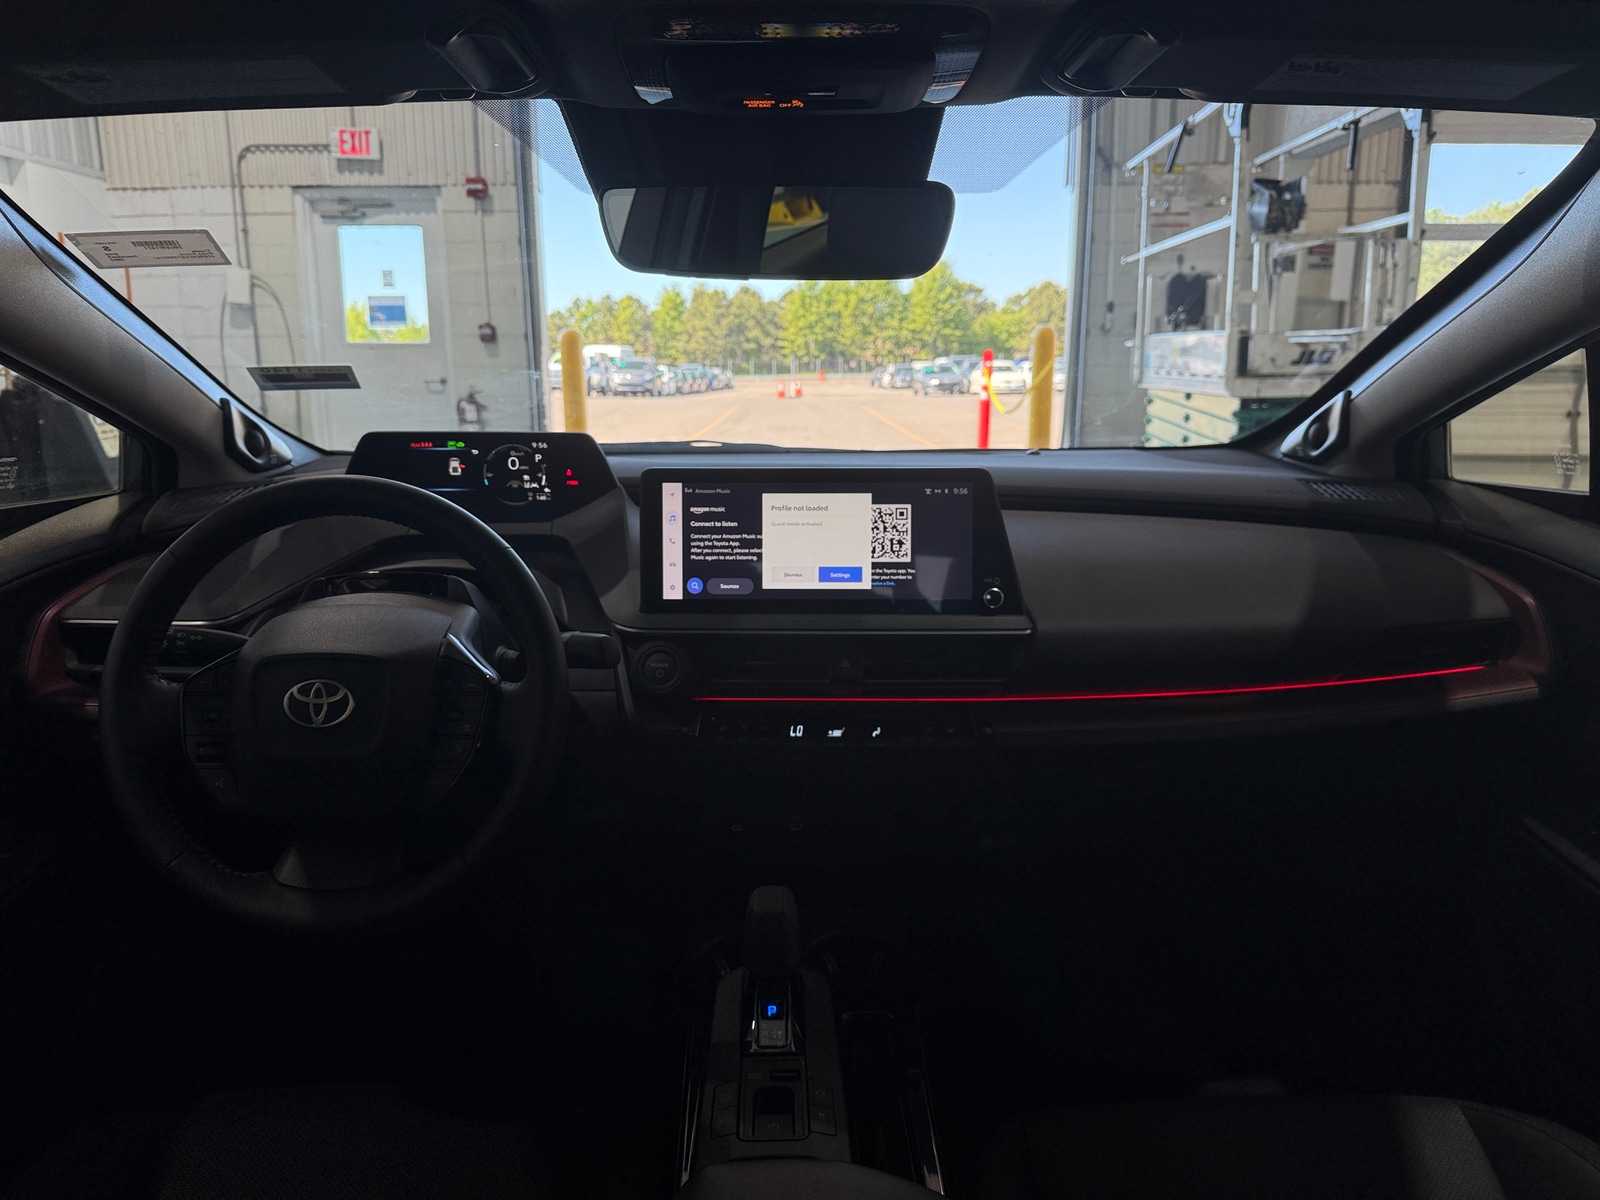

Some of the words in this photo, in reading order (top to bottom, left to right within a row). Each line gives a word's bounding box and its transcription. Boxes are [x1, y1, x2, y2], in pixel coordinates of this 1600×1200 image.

[338, 129, 372, 157] EXIT
[1289, 349, 1337, 366] JLG
[535, 453, 542, 463] P
[508, 456, 520, 471] 0
[953, 487, 968, 495] 9:56
[690, 506, 709, 514] amazon
[771, 504, 792, 512] Profile
[805, 504, 829, 512] loaded
[768, 1005, 777, 1016] P
